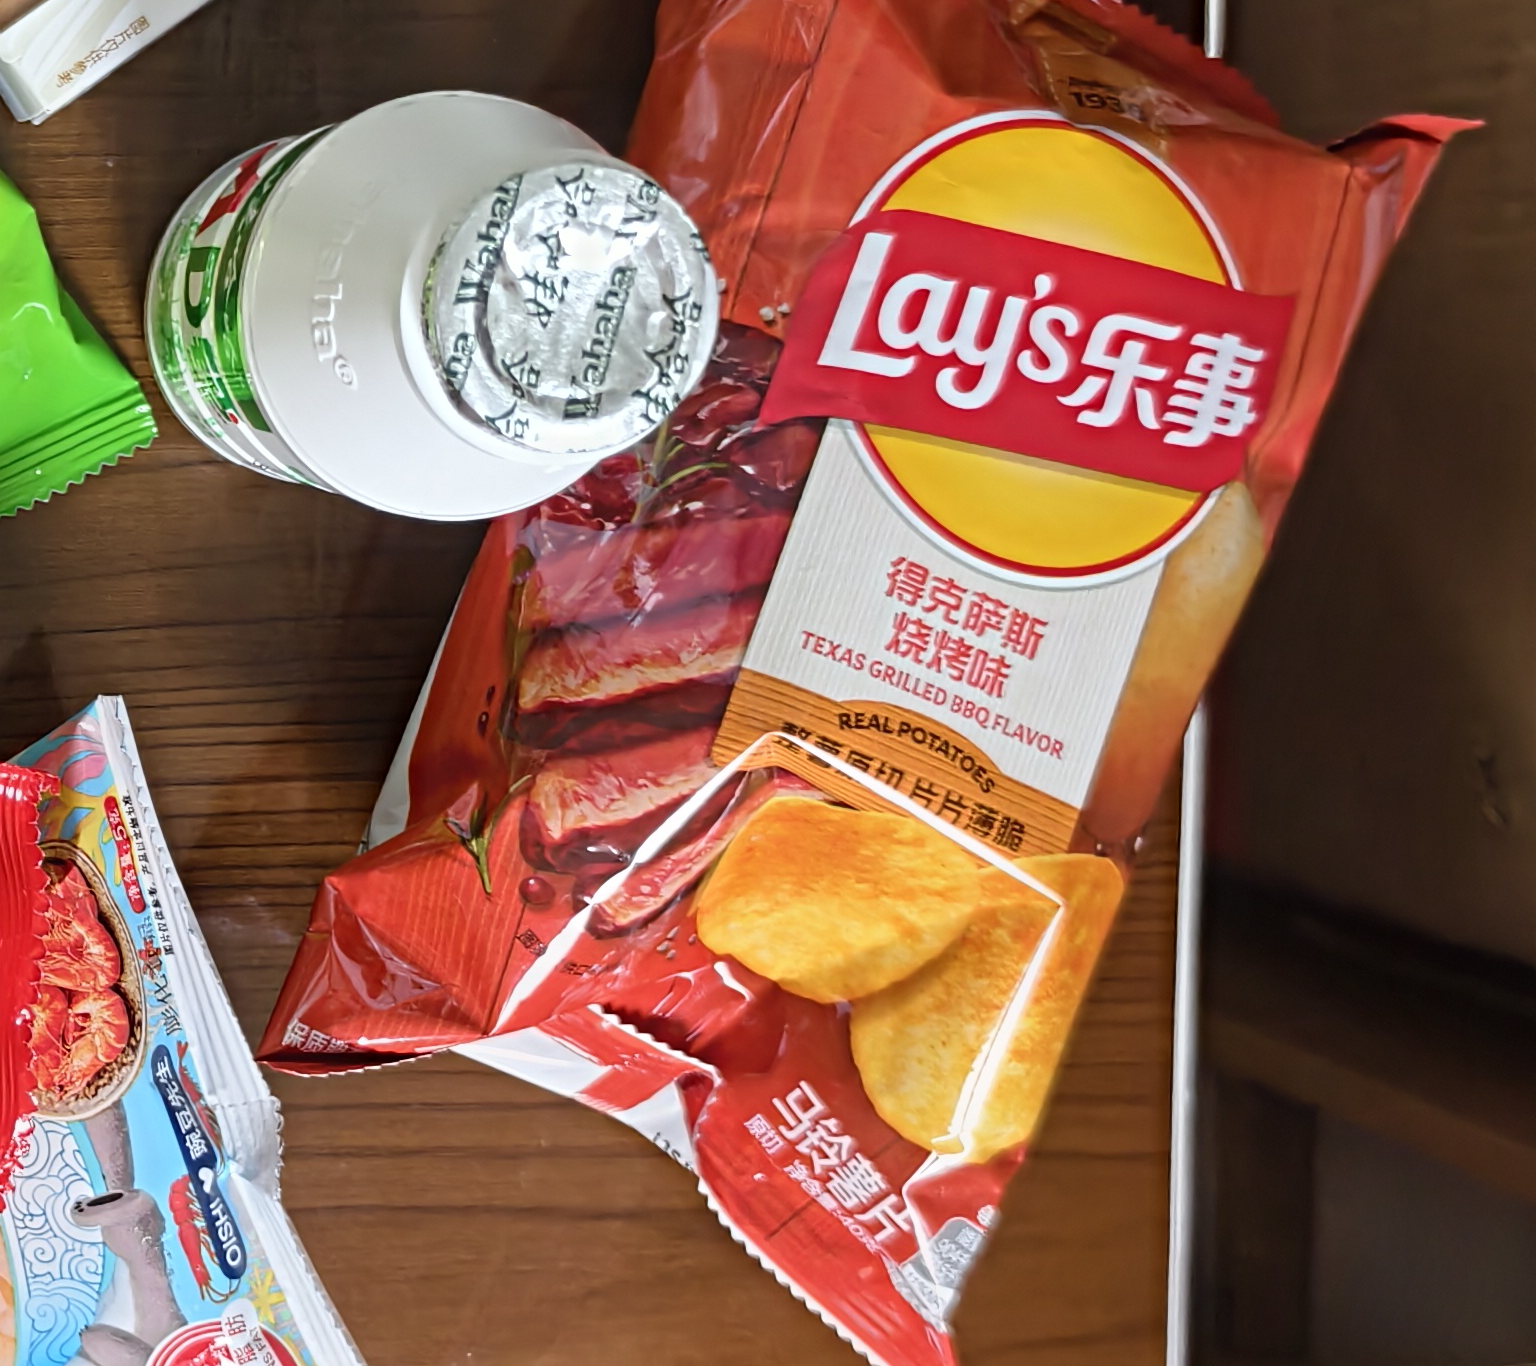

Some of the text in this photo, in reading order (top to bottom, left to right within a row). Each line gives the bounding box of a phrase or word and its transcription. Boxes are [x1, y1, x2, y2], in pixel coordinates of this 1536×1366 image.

[54, 15, 149, 88] 图片仅供参考
[817, 232, 1265, 449] Lay's 乐事
[884, 611, 1013, 699] 烧烤味
[885, 555, 1049, 661] 得克萨斯
[801, 630, 1065, 760] TEXAS GRILLED BBQ FLAVOR
[838, 711, 997, 795] REAL POTATOES
[155, 1054, 244, 1267] OISHI 豌豆先生
[771, 1079, 913, 1242] 马铃薯片
